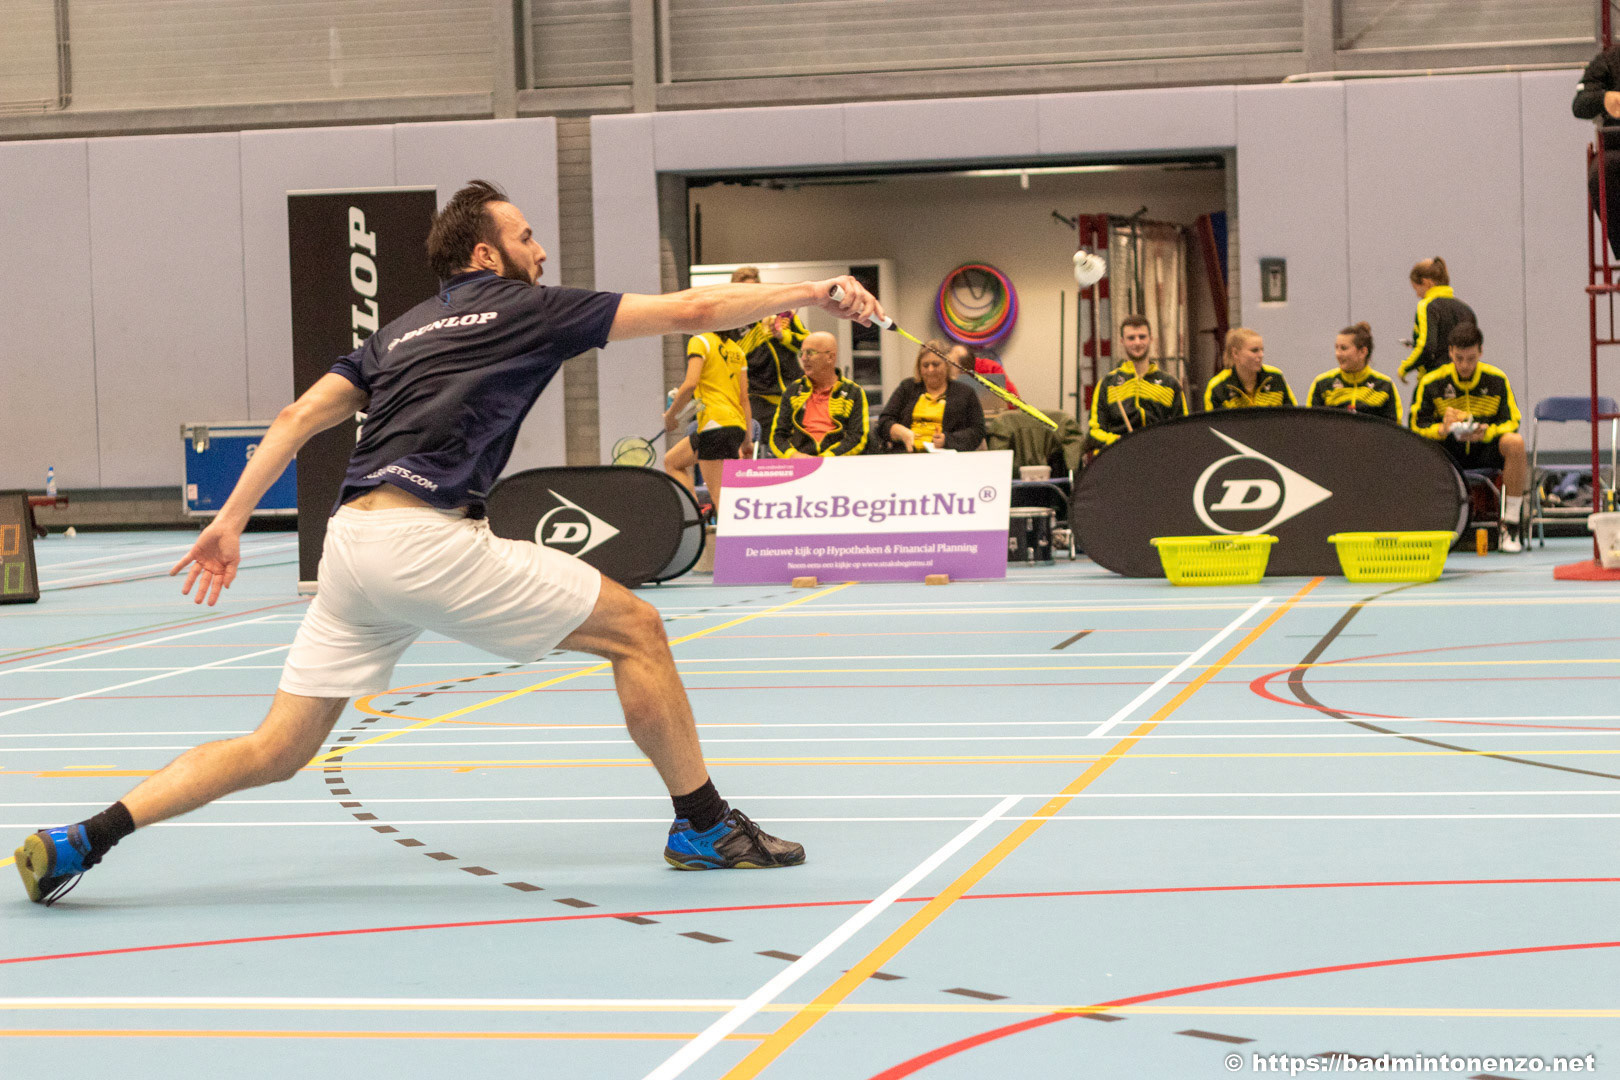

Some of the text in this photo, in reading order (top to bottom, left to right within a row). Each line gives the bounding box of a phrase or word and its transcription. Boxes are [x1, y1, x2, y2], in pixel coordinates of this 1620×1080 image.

[399, 311, 498, 342] DUNLOP
[1210, 479, 1281, 511] D
[545, 522, 589, 544] D
[745, 543, 978, 558] De nieuwe kijk op Hypotheken & Financial Planning
